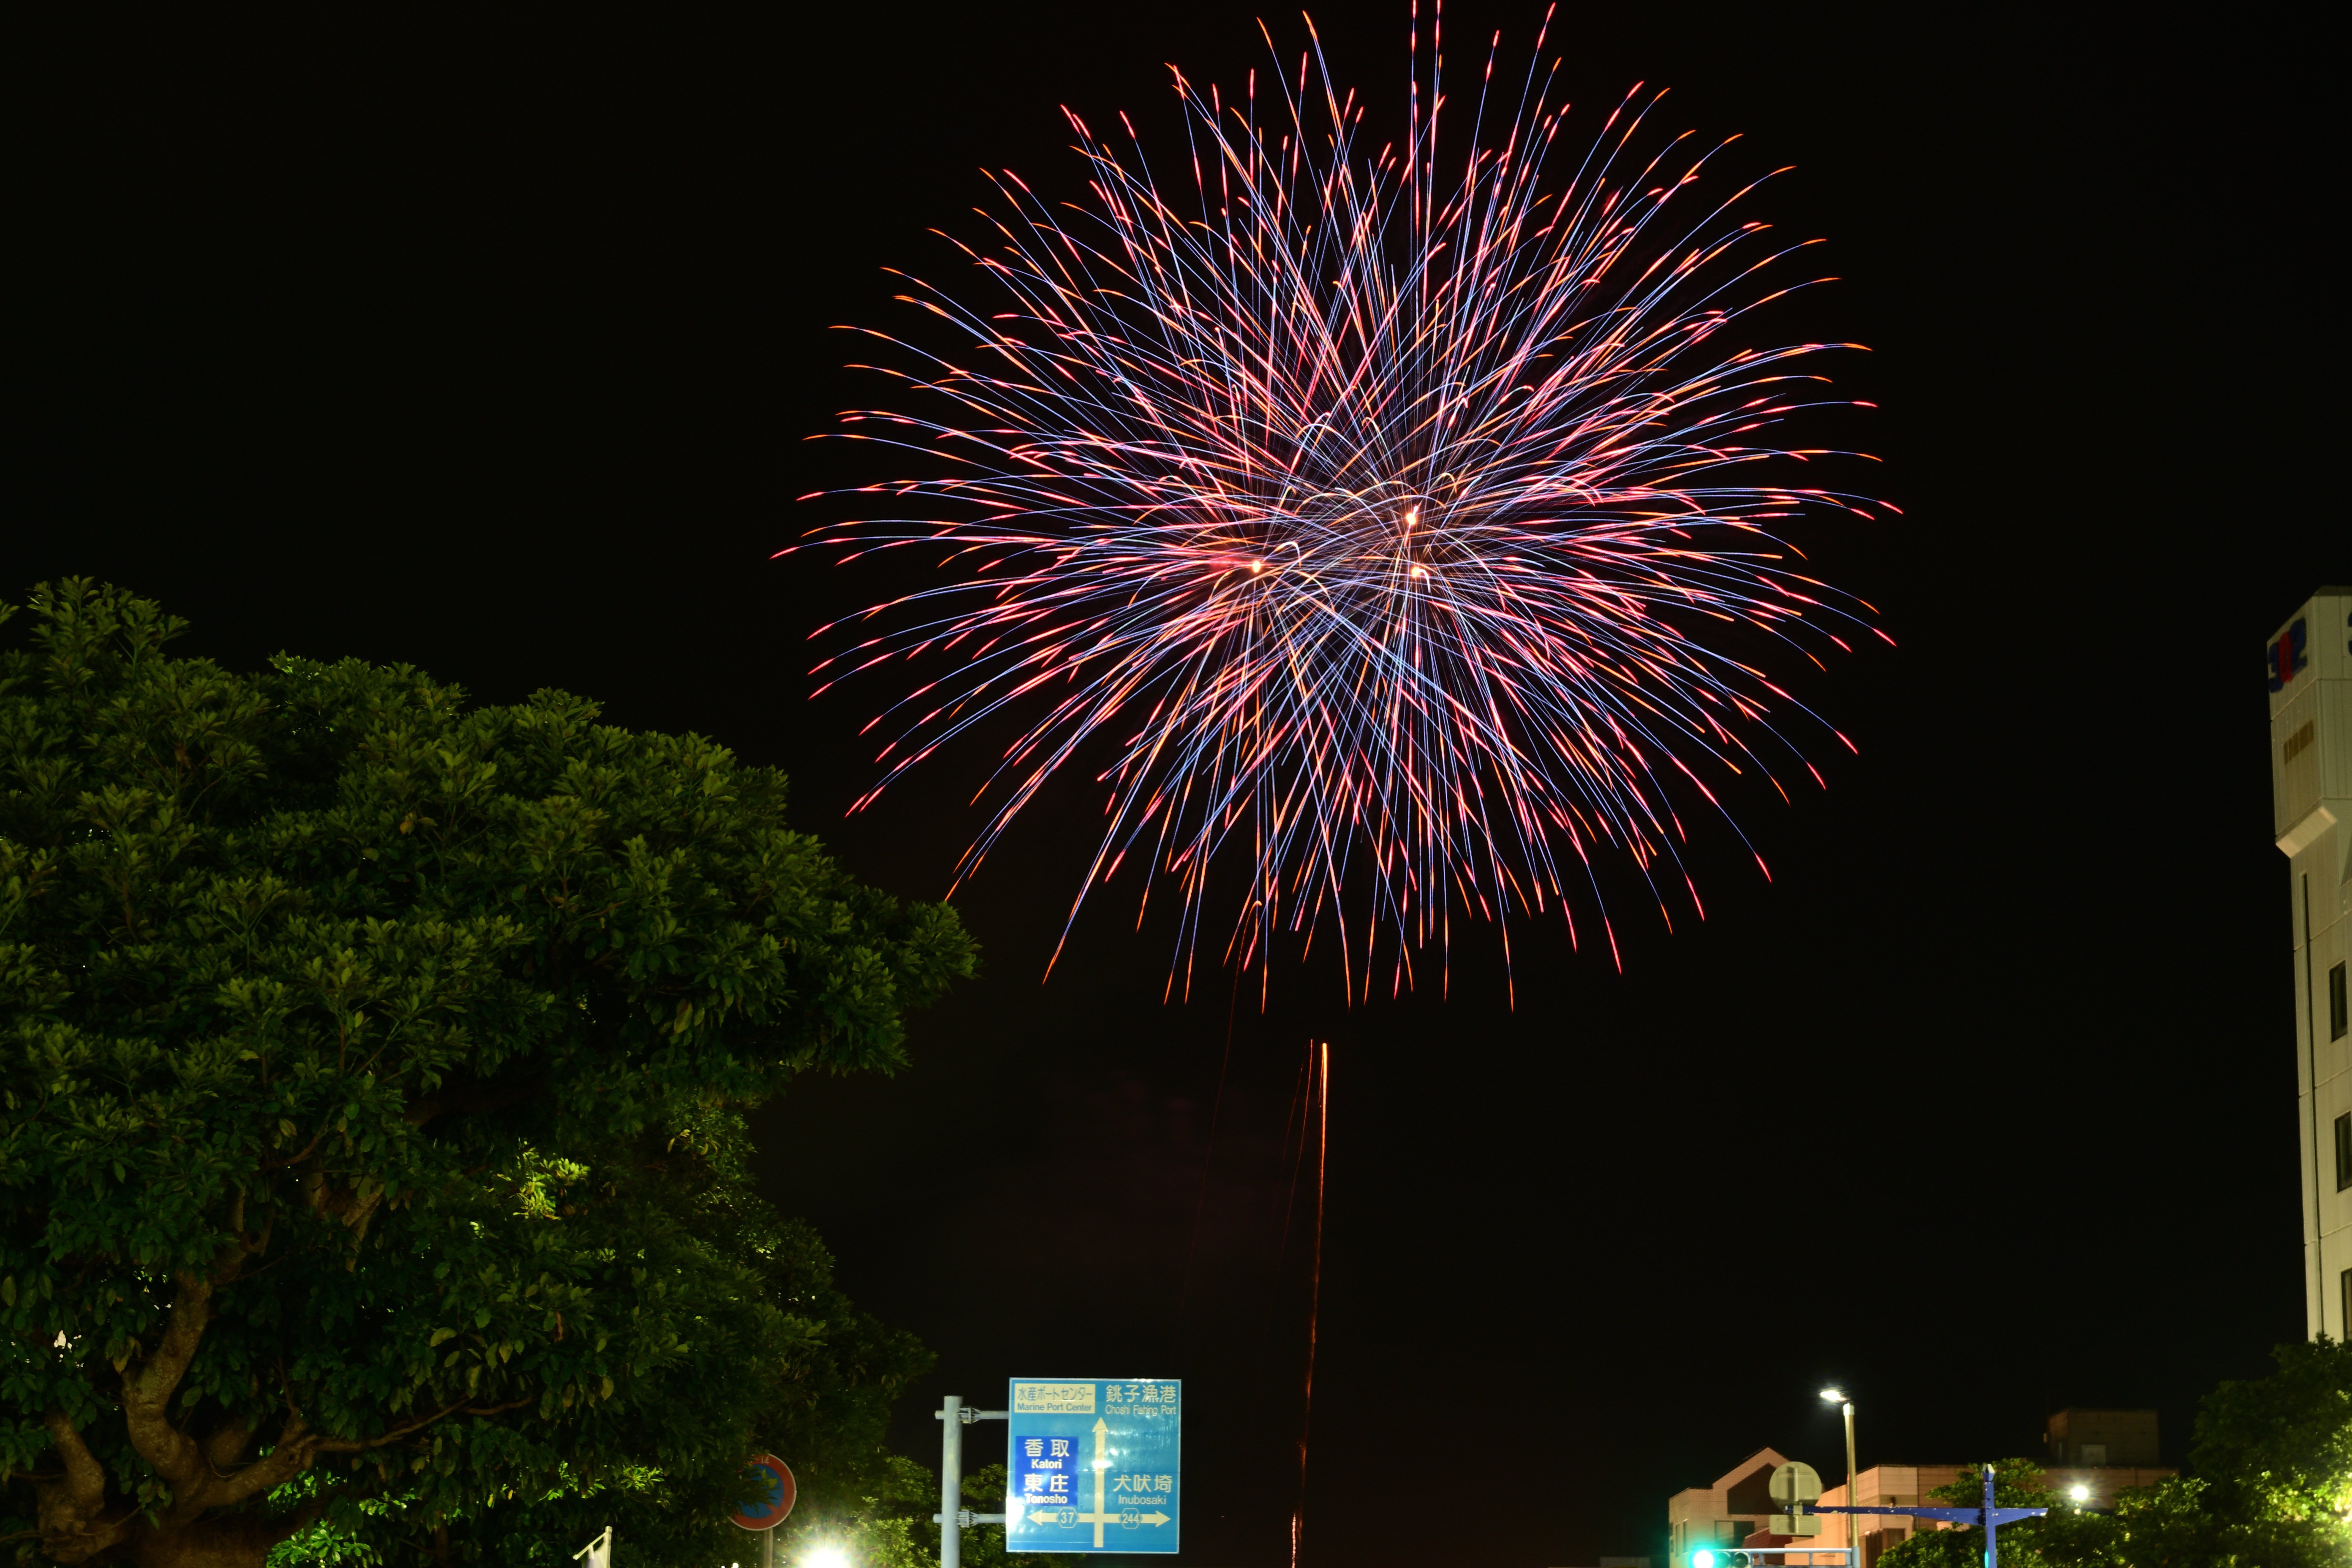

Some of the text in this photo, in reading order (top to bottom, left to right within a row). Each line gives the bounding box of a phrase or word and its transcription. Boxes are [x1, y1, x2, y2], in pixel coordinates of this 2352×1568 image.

[1018, 1386, 1093, 1401] 水産ポートセンター
[1106, 1385, 1176, 1402] 銚子漁港
[1018, 1403, 1044, 1411] Marine
[1105, 1405, 1176, 1416] Choshi Fishing Port
[1024, 1439, 1070, 1457] 香取
[1031, 1459, 1062, 1469] Katori
[1024, 1473, 1069, 1492] 東庄
[1113, 1474, 1173, 1492] 犬吠埼
[1024, 1493, 1068, 1504] Tonosho
[1119, 1494, 1166, 1505] Inubosaki
[1061, 1512, 1075, 1523] 37
[1123, 1514, 1139, 1523] 244
